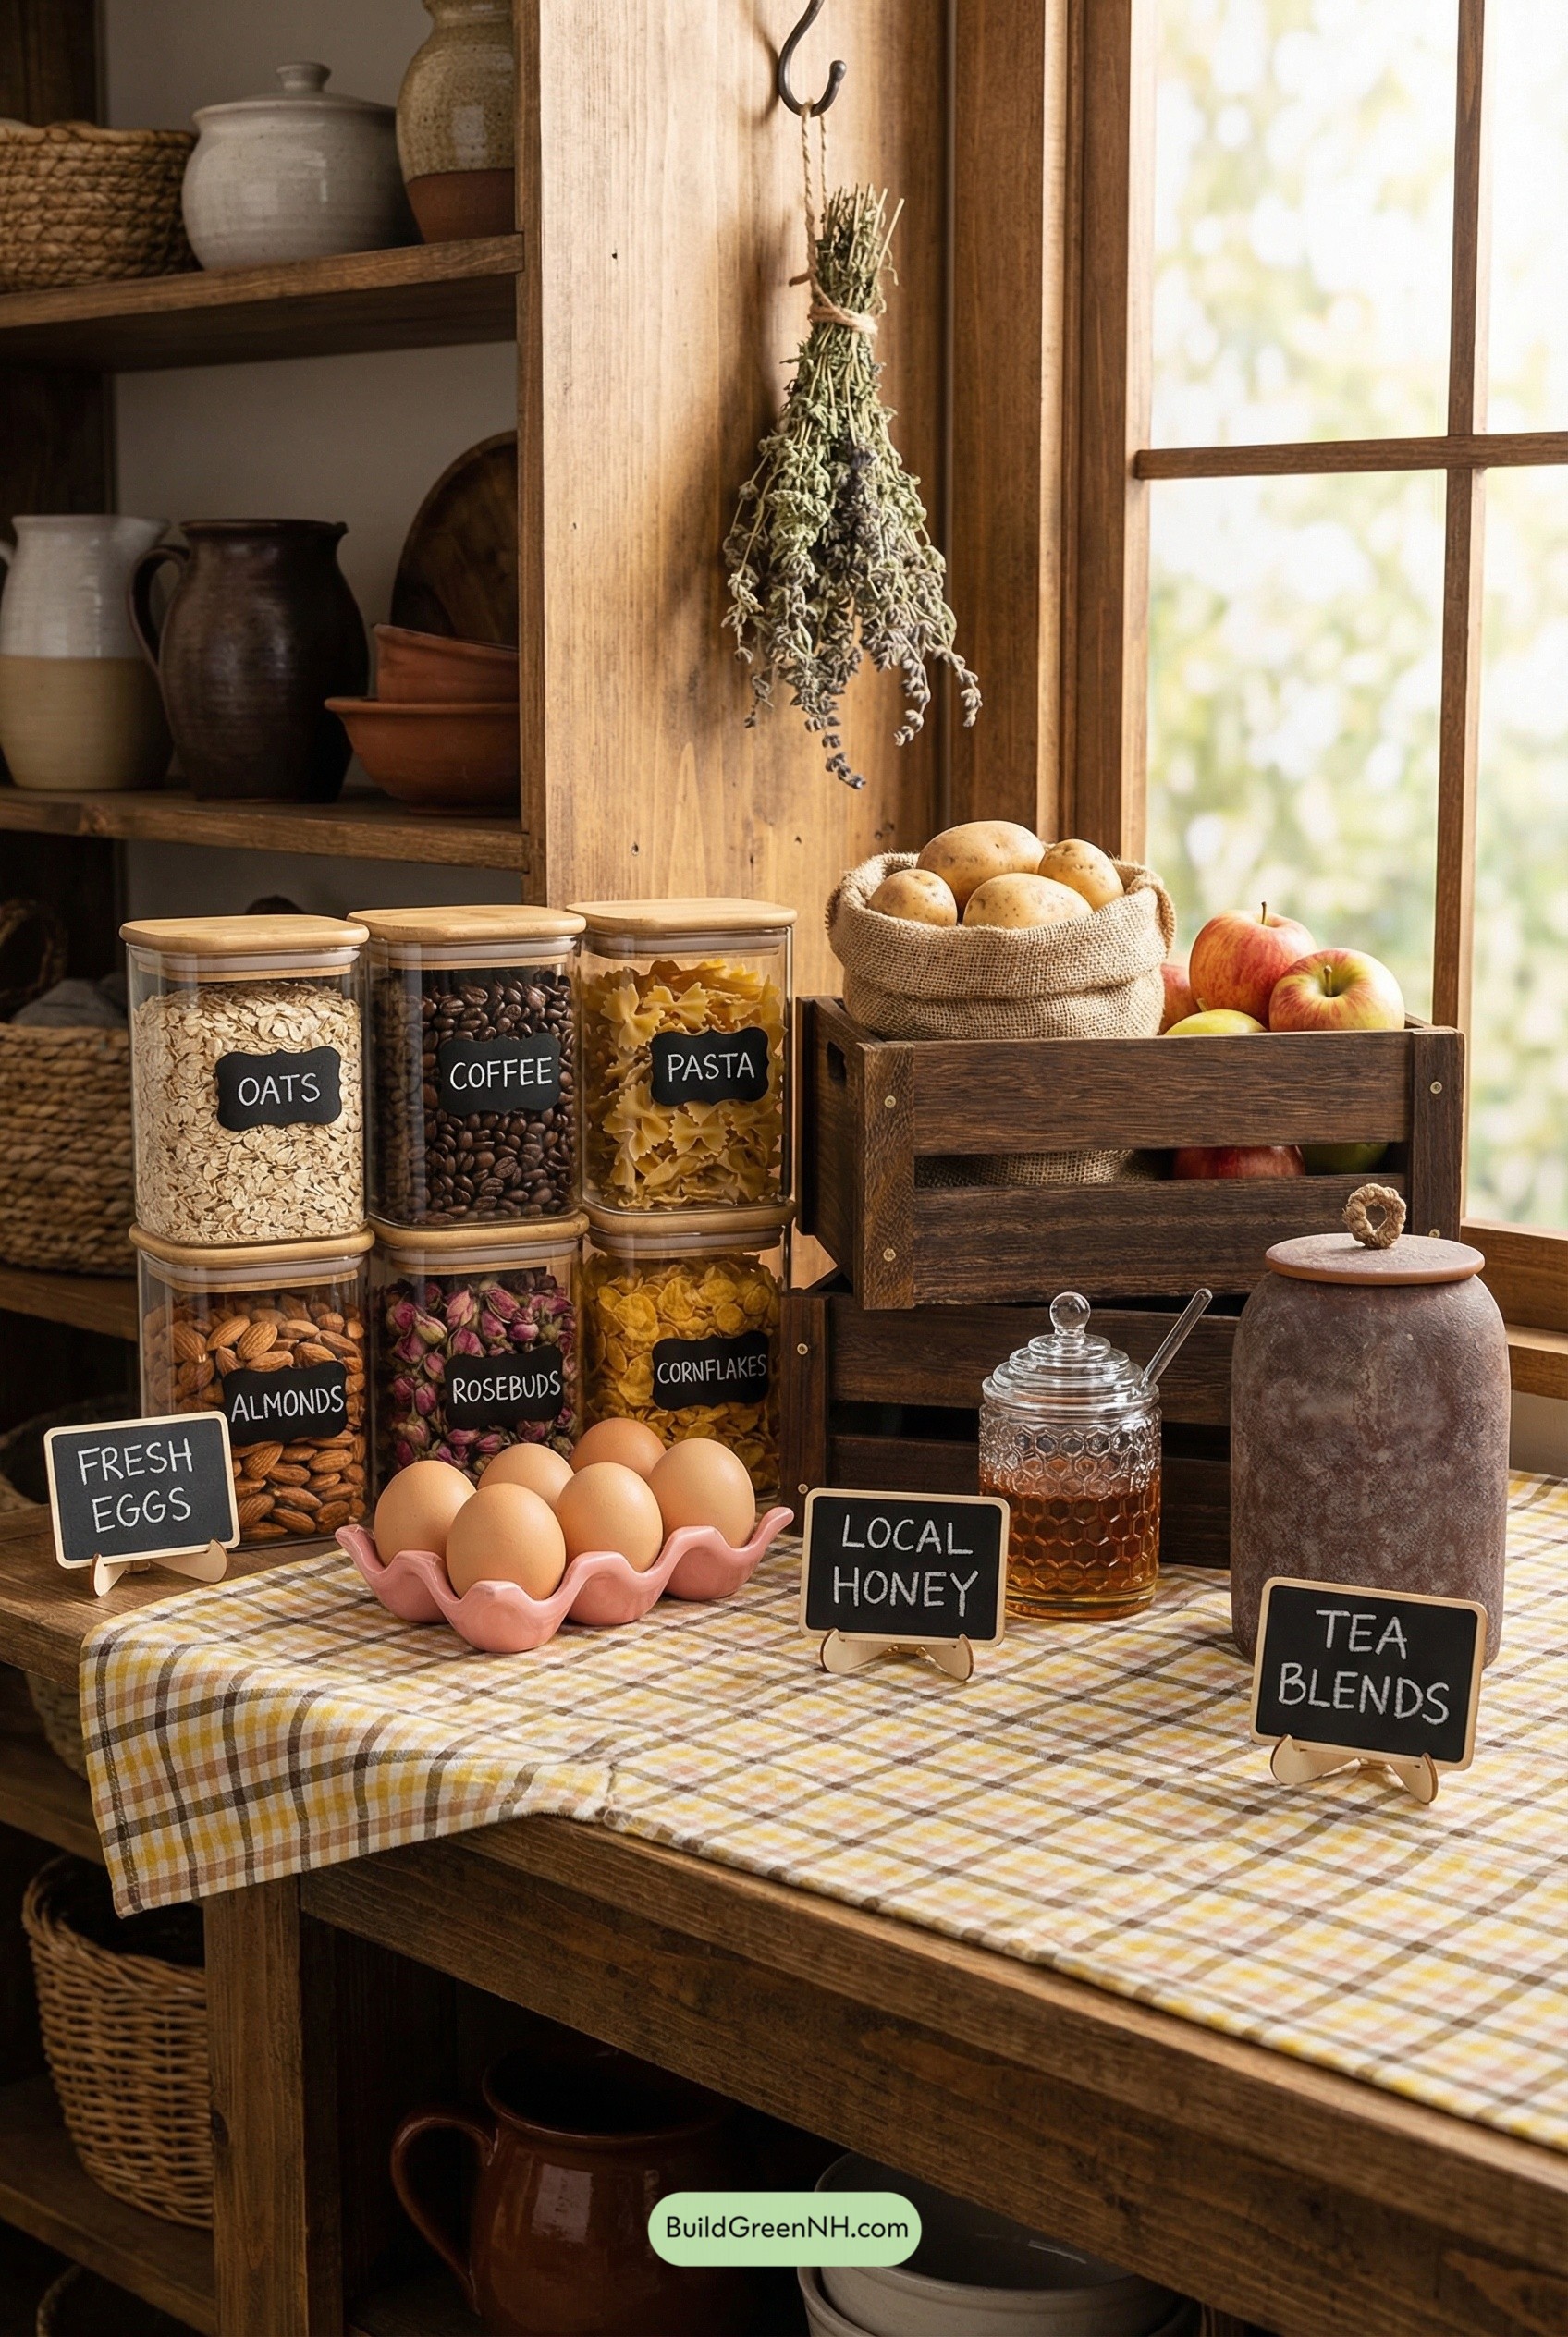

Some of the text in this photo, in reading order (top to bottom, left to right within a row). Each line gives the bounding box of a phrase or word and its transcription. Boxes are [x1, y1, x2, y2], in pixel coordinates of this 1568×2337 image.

[449, 1056, 553, 1091] COFFEE
[667, 1051, 755, 1083] PASTA
[238, 1072, 321, 1107] OATS
[452, 1370, 561, 1404] ROSEBUDS
[655, 1353, 767, 1385] CORNFLAKES
[231, 1385, 344, 1423] ALMONDS
[77, 1438, 193, 1485] FRESH
[92, 1487, 192, 1534] EGGS
[841, 1514, 974, 1555] LOCAL
[833, 1565, 979, 1618] HONEY
[1315, 1609, 1409, 1660] TEA
[1278, 1662, 1450, 1725] BLENDS
